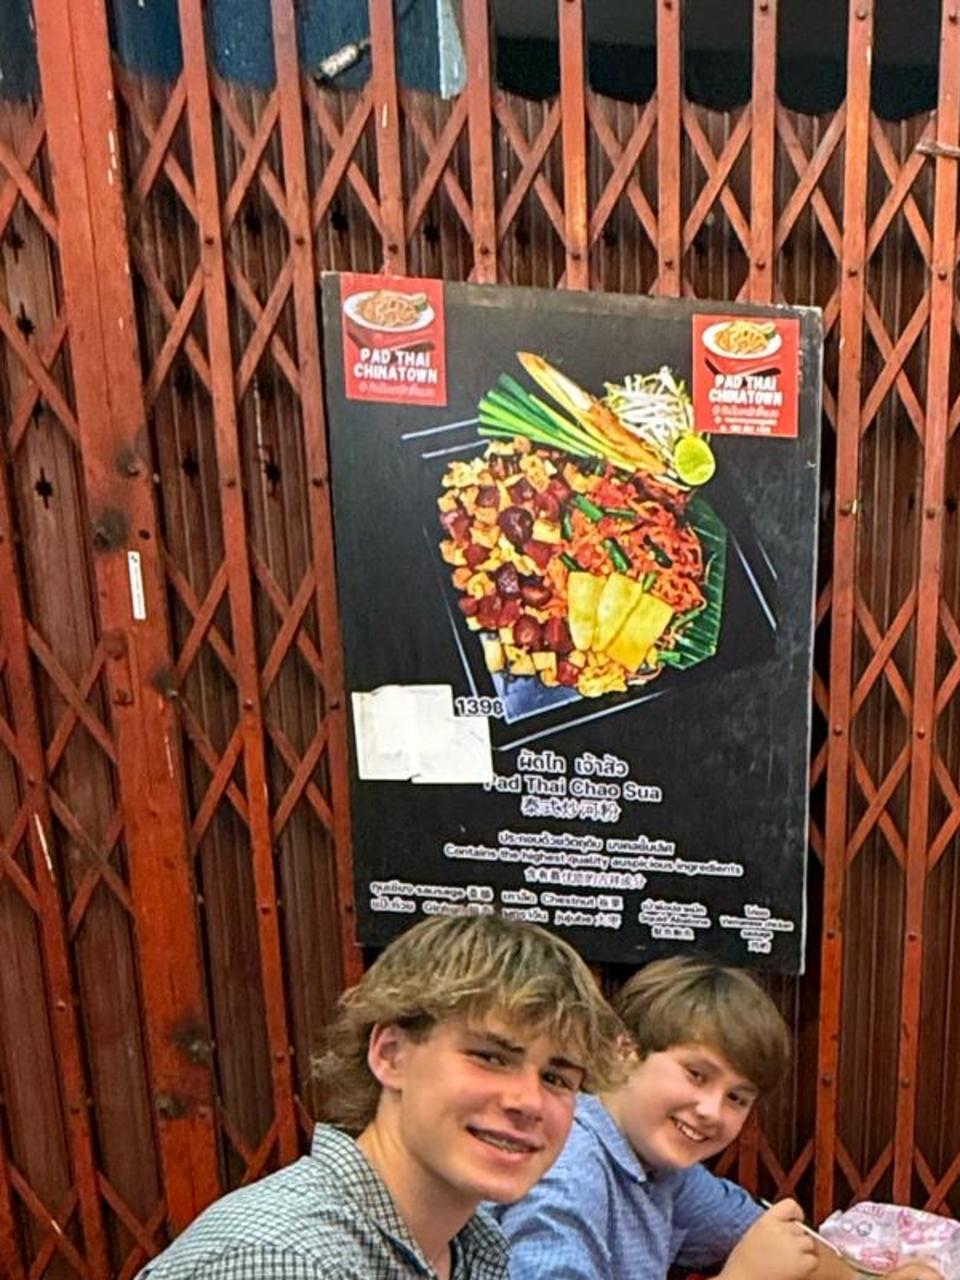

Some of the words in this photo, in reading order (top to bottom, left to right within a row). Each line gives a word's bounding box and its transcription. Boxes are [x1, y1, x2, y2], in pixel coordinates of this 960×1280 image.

[361, 348, 391, 364] PAD
[395, 350, 431, 367] THAI
[353, 363, 438, 384] CHINATOWN
[714, 373, 743, 389] PAD
[746, 375, 777, 391] THAI
[708, 388, 783, 407] CHINATOWN
[523, 774, 567, 796] Thai
[568, 778, 622, 800] Chao
[622, 782, 663, 802] Sua
[443, 843, 498, 861] Contains
[498, 847, 520, 862] the
[520, 848, 566, 866] highest
[566, 851, 610, 870] quality
[610, 855, 675, 872] auspicious
[675, 858, 744, 877] ingredients
